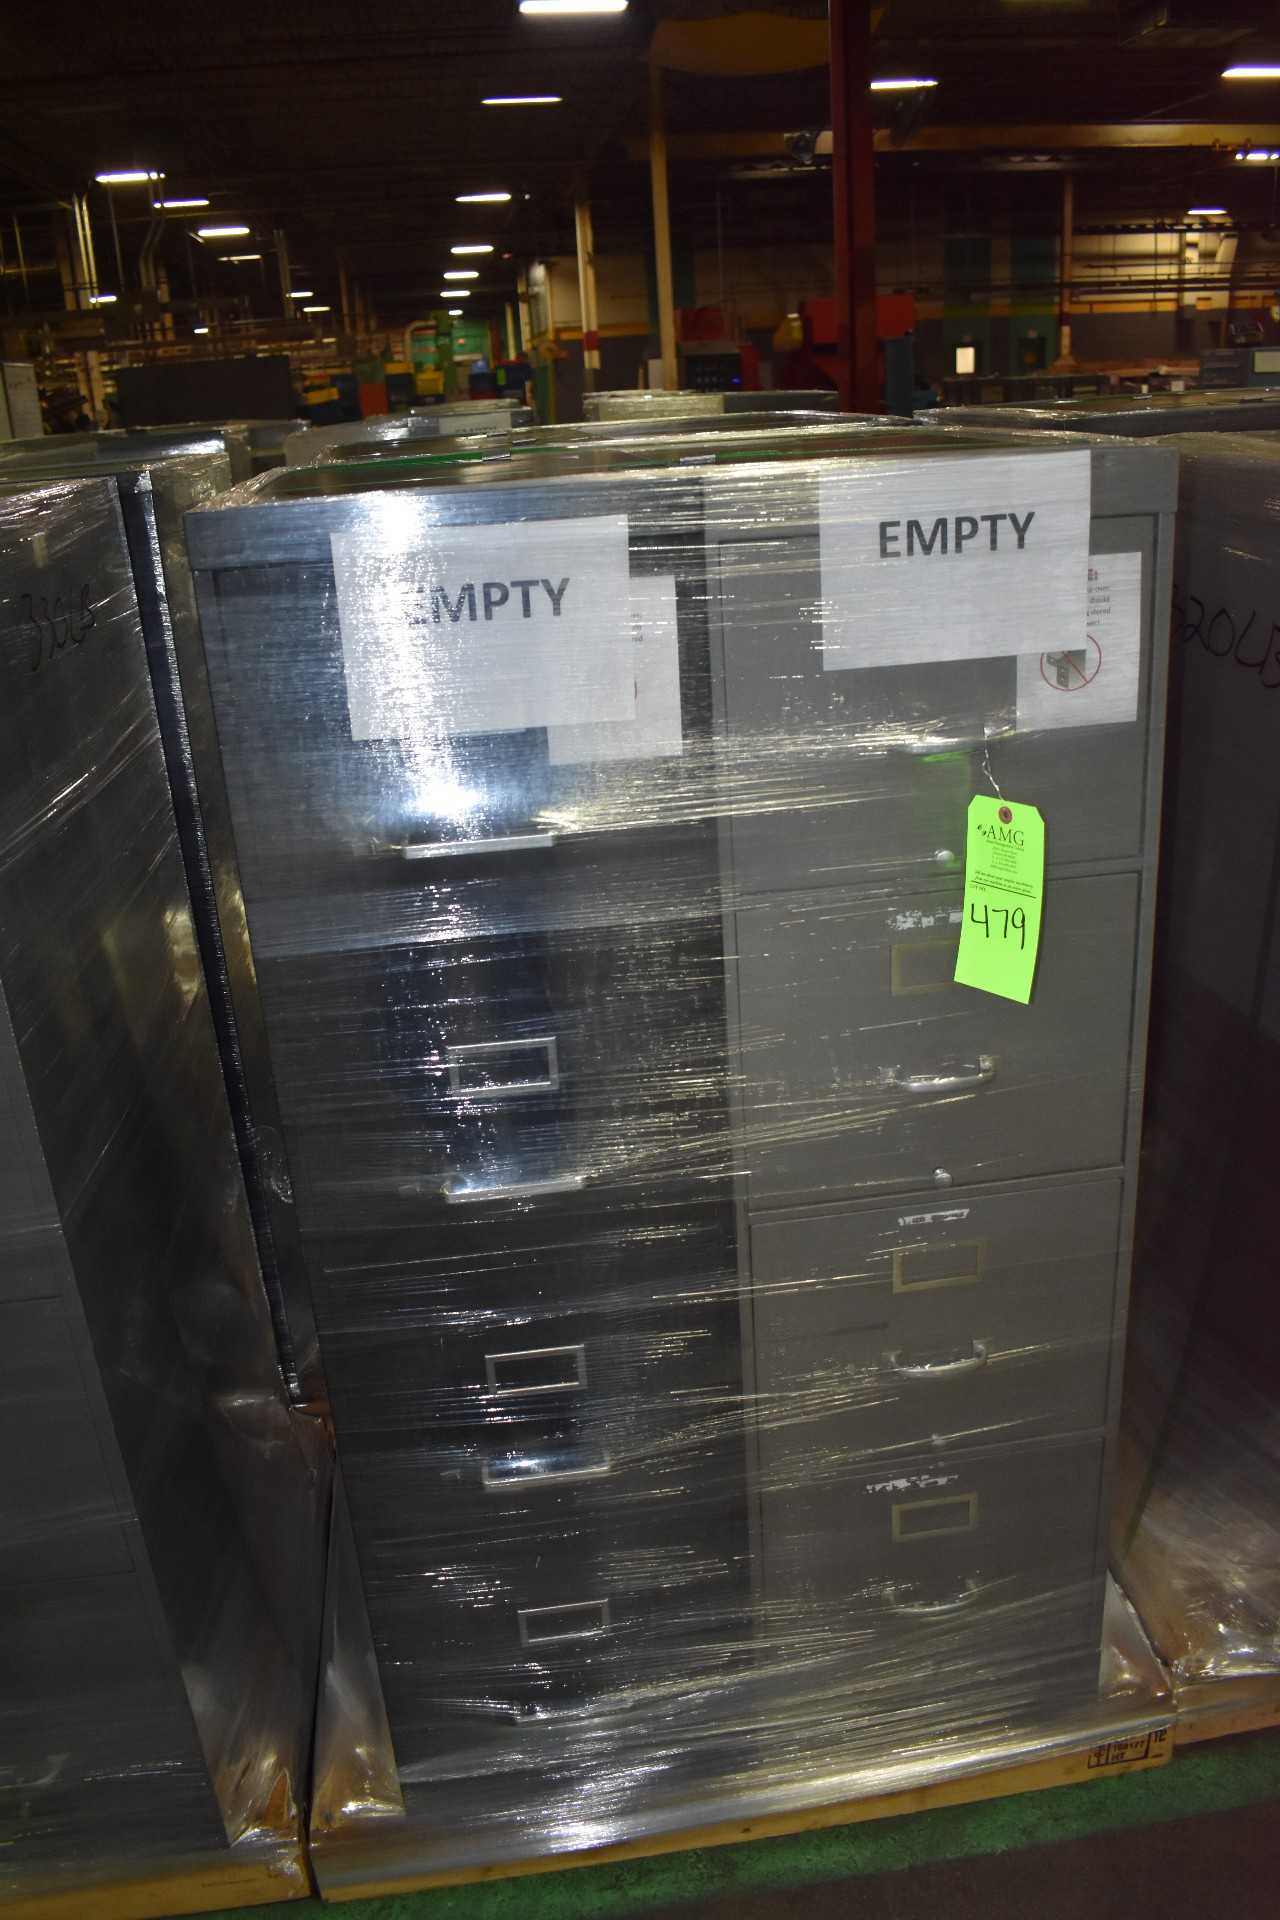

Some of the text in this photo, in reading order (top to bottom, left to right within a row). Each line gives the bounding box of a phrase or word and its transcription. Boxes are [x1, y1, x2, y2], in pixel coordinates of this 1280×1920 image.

[879, 511, 1036, 559] EMPTY
[985, 824, 1026, 847] AMG
[970, 903, 1026, 951] 479
